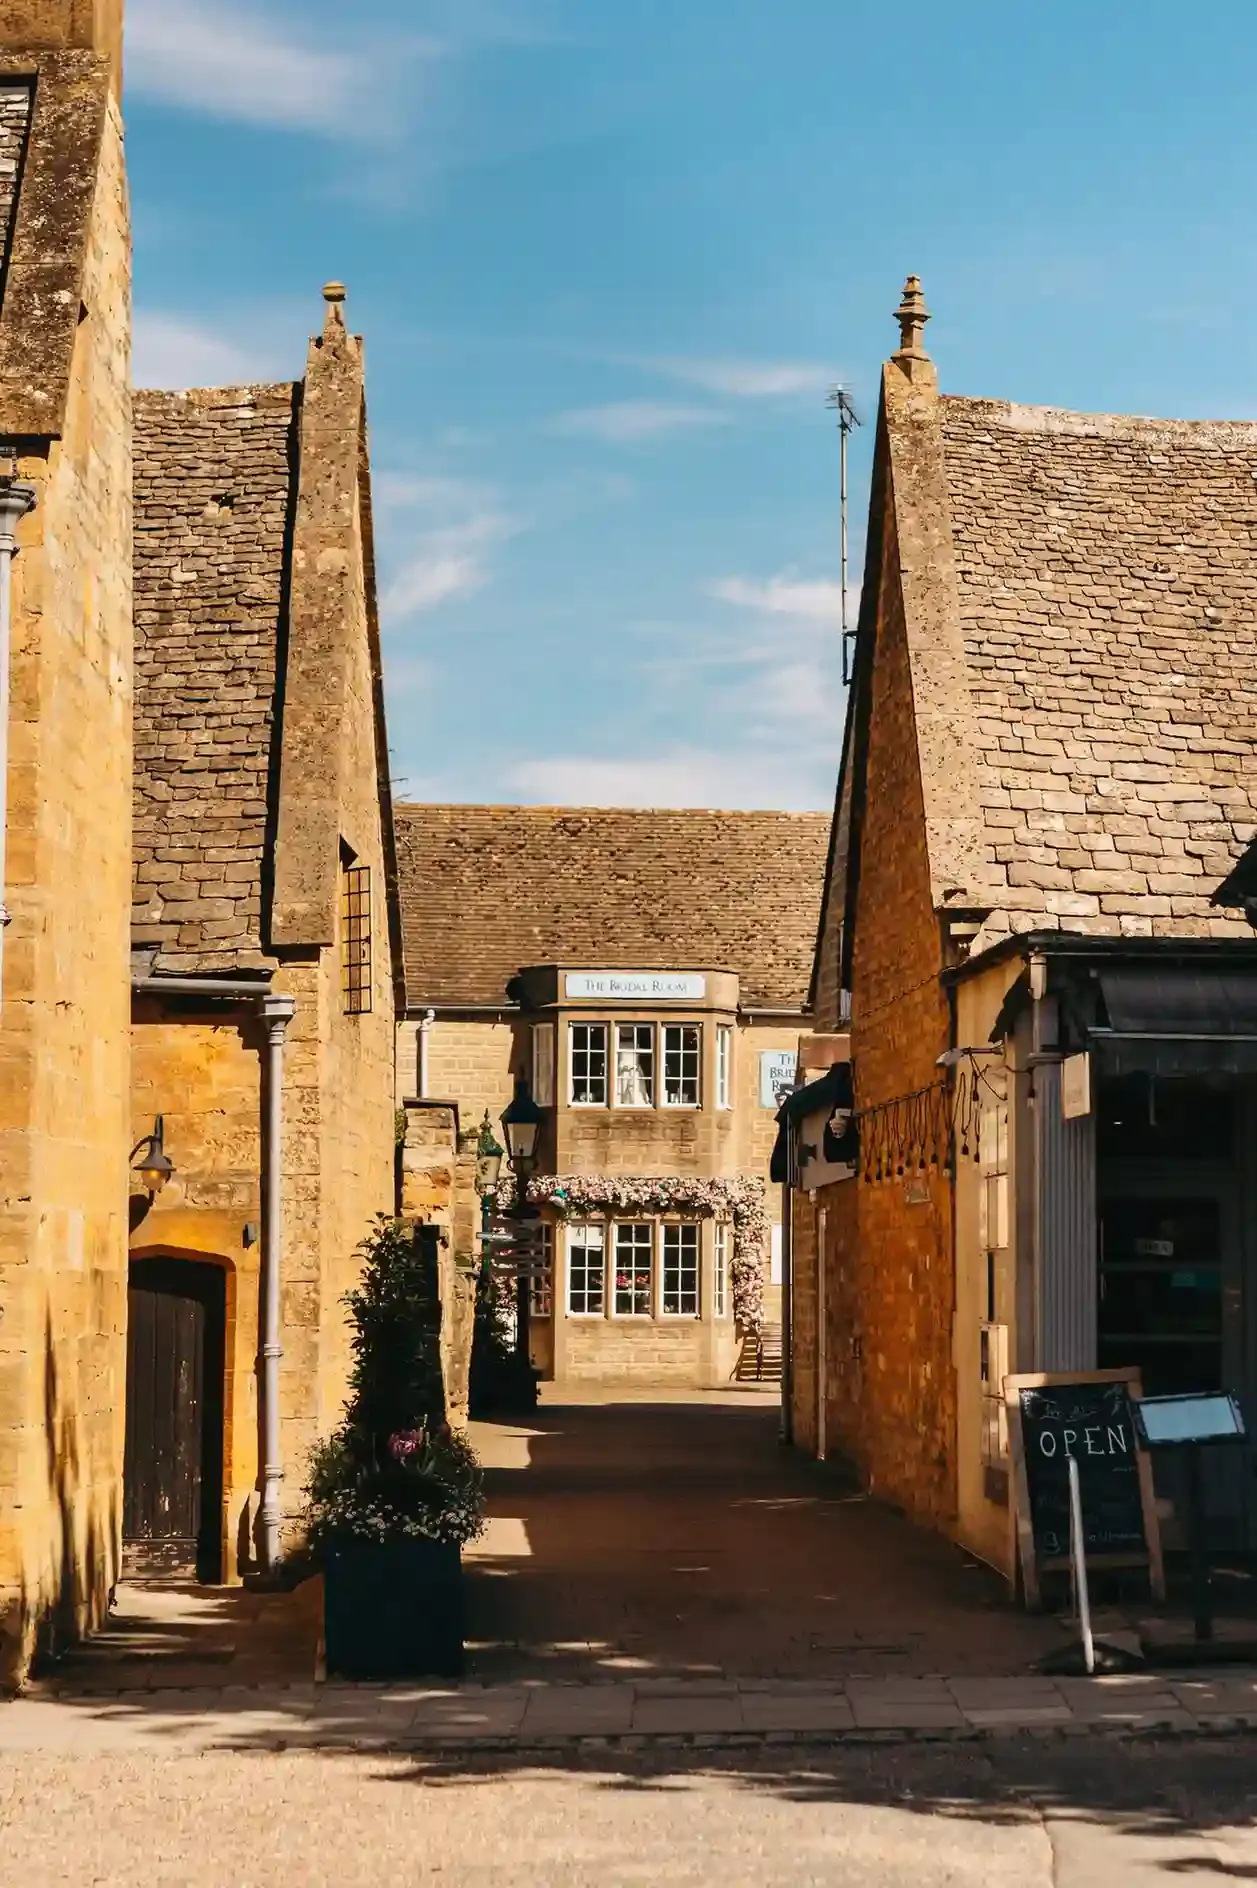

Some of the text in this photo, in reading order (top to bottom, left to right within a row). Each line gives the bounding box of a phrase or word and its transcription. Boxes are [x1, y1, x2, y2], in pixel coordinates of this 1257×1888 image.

[778, 1053, 796, 1065] TH
[769, 1067, 796, 1079] BRID
[1039, 1424, 1128, 1458] OPEN
